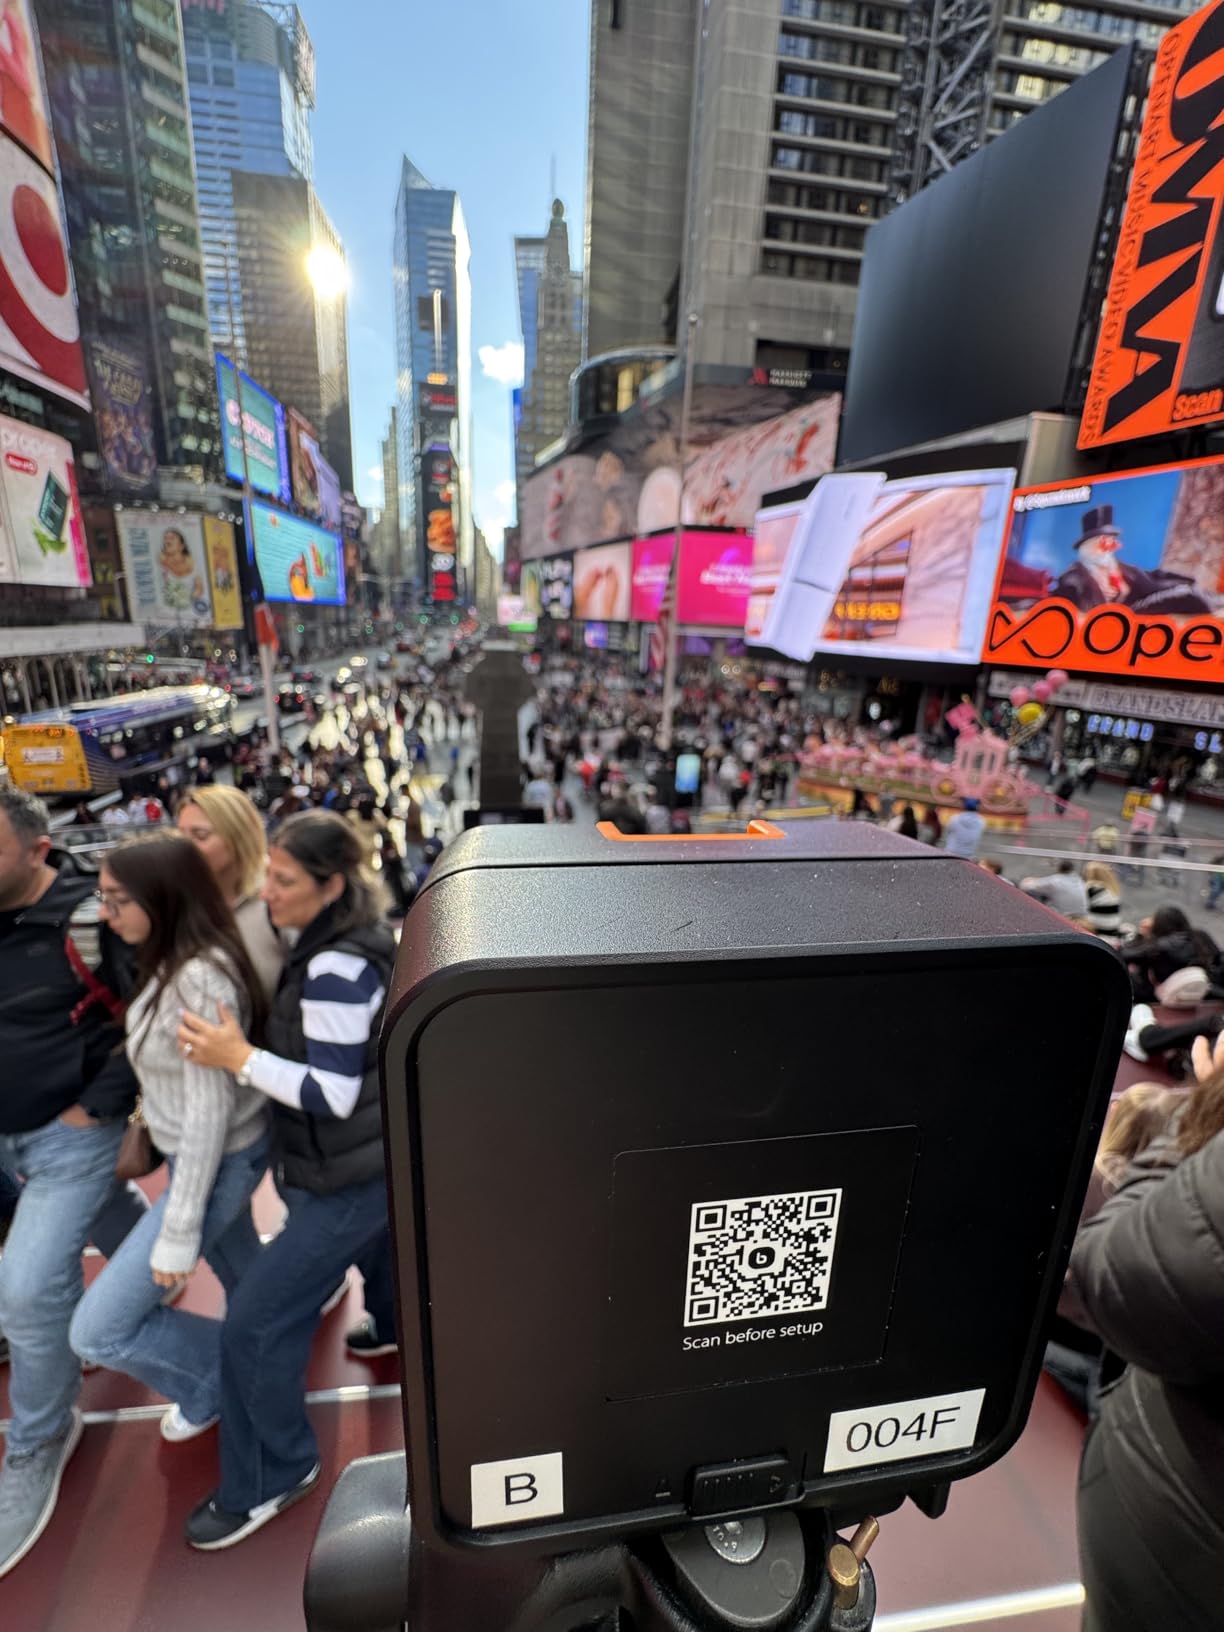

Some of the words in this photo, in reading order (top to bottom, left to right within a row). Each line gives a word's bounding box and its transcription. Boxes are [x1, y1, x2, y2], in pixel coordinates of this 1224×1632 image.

[1140, 33, 1180, 162] OPENART
[1119, 167, 1152, 260] MUSIC
[1104, 257, 1138, 340] VIDEO
[1083, 348, 1114, 442] AWARDS
[1083, 611, 1223, 667] Ope
[682, 1336, 721, 1350] Scan
[725, 1327, 776, 1344] before
[779, 1321, 824, 1337] setup
[846, 1406, 961, 1452] 004F
[504, 1472, 539, 1506] B
